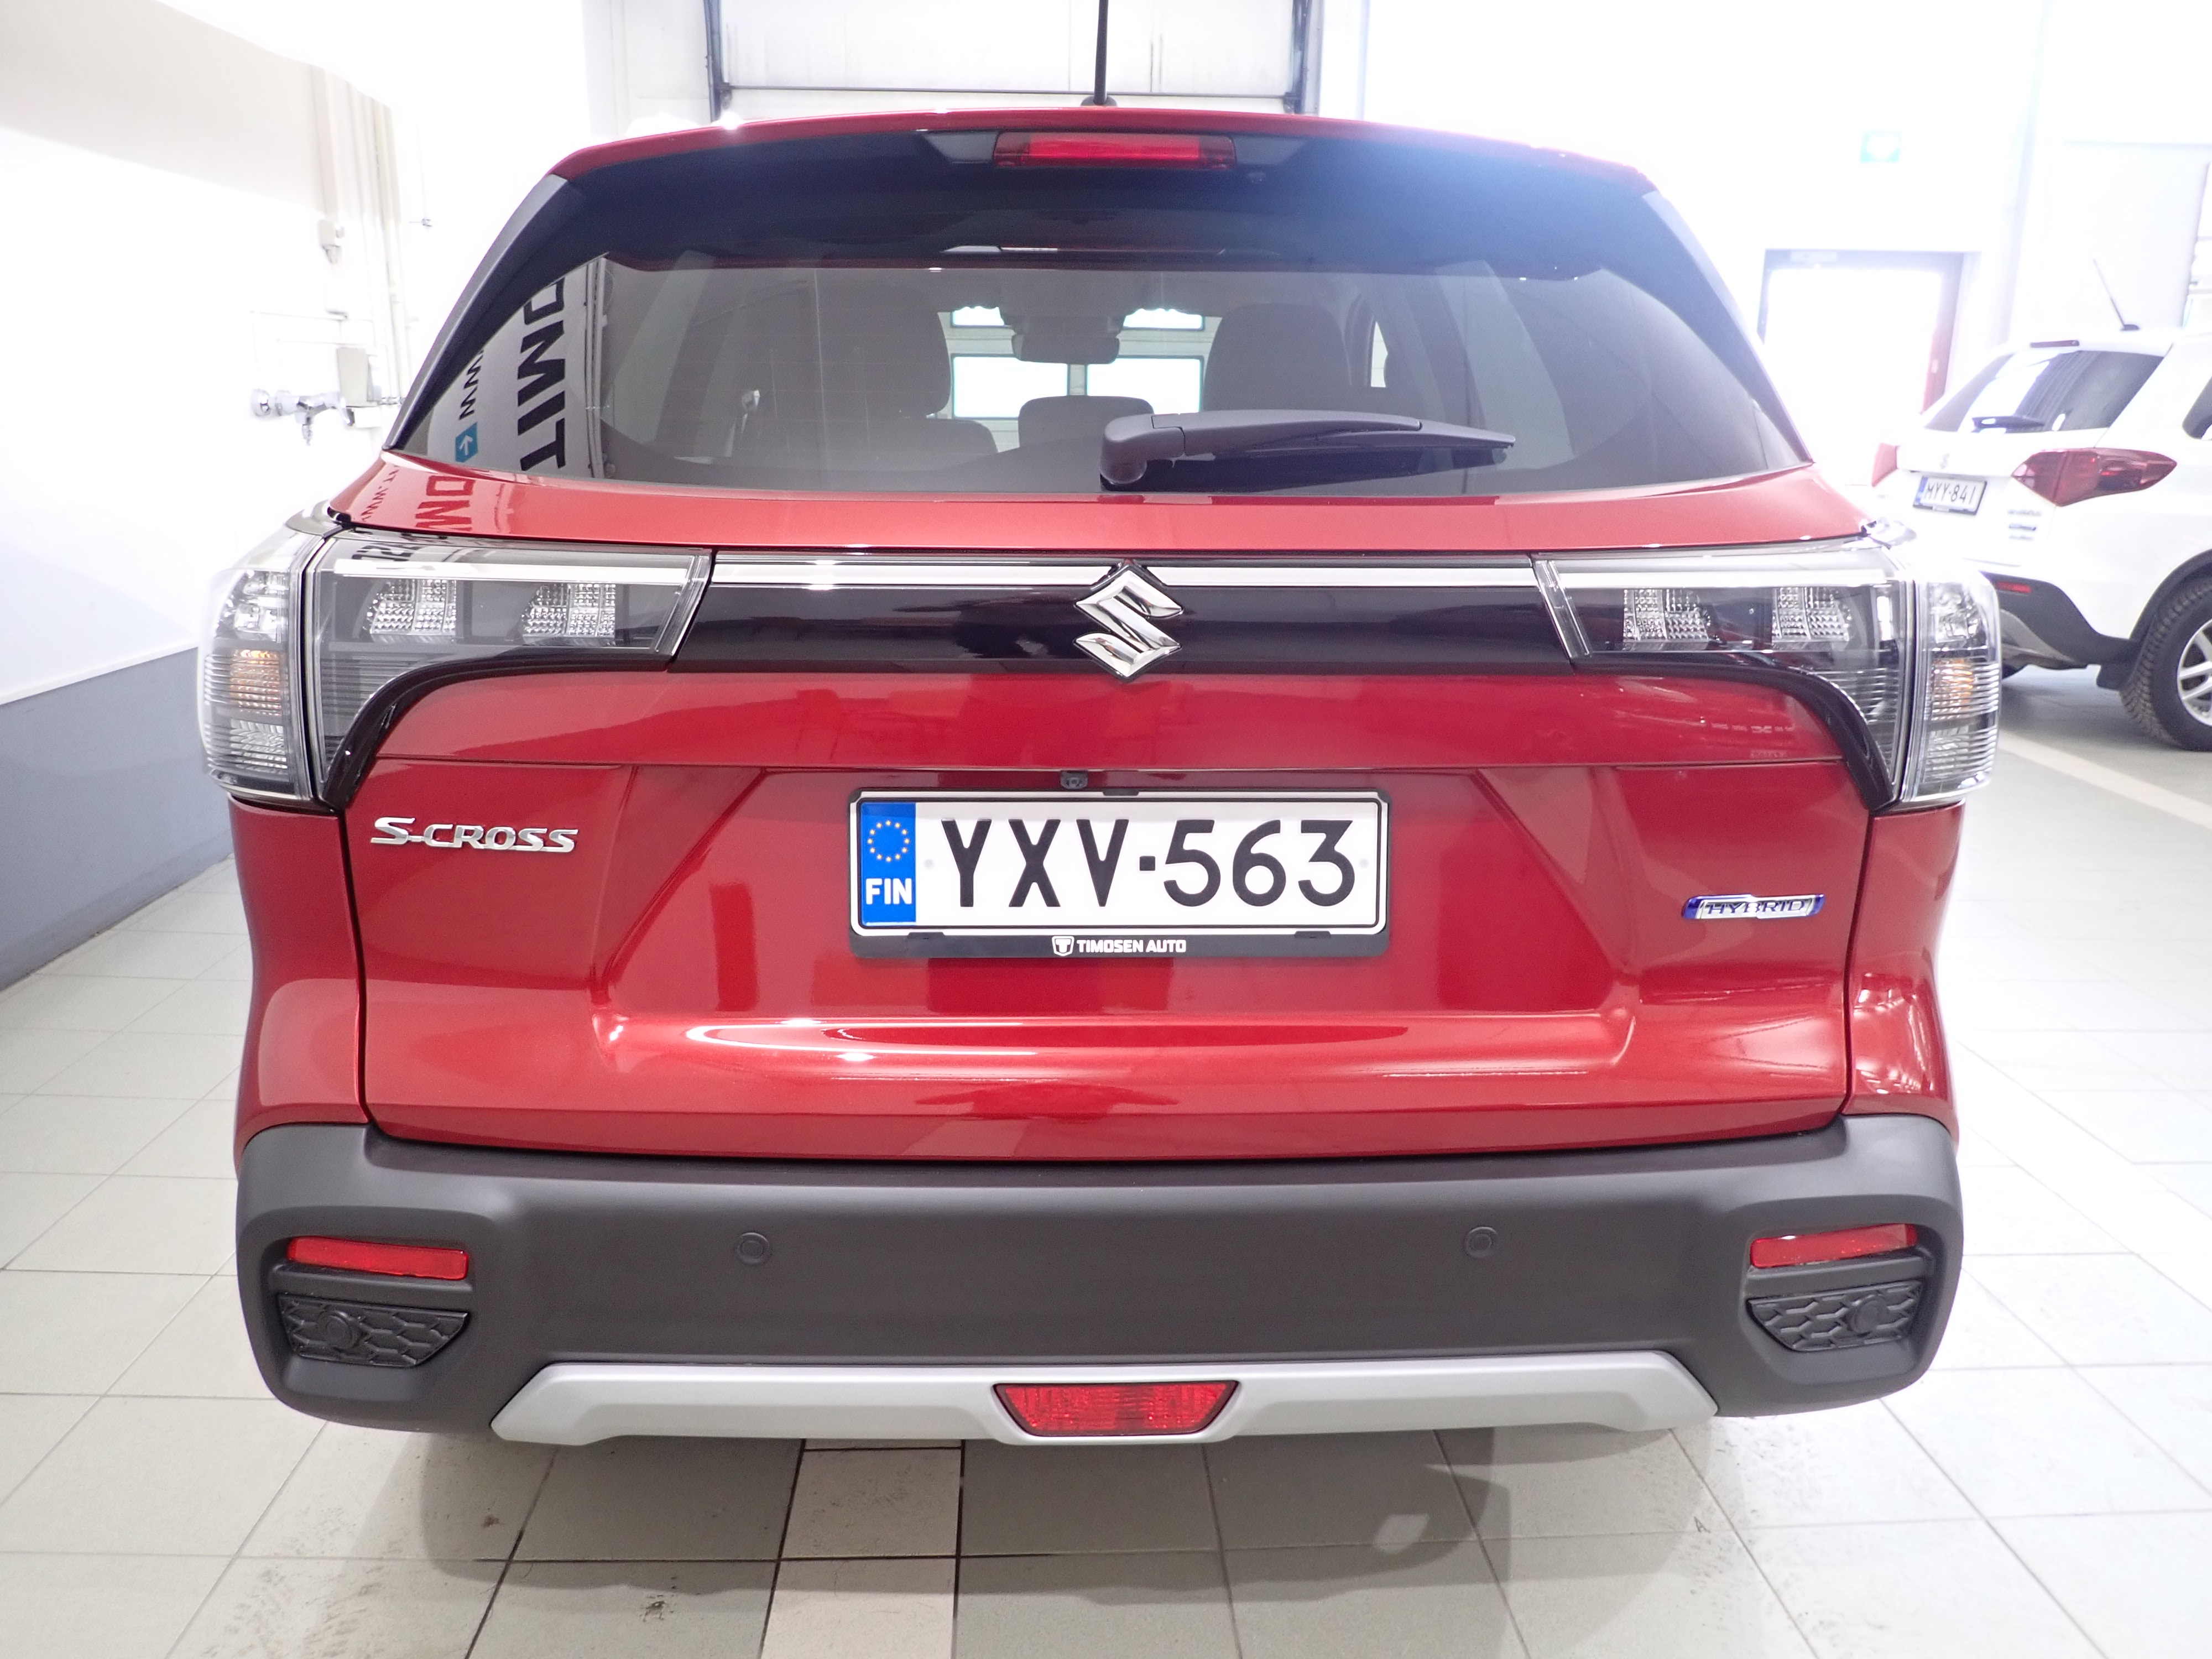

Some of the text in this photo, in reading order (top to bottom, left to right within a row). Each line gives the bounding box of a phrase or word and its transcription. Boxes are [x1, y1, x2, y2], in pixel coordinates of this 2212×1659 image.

[371, 817, 578, 853] S-CROSS
[941, 819, 1355, 907] YXV-563
[866, 878, 912, 905] FIN
[1707, 900, 1806, 915] HYBRID
[1076, 939, 1187, 953] TIMOSEN AUTO
